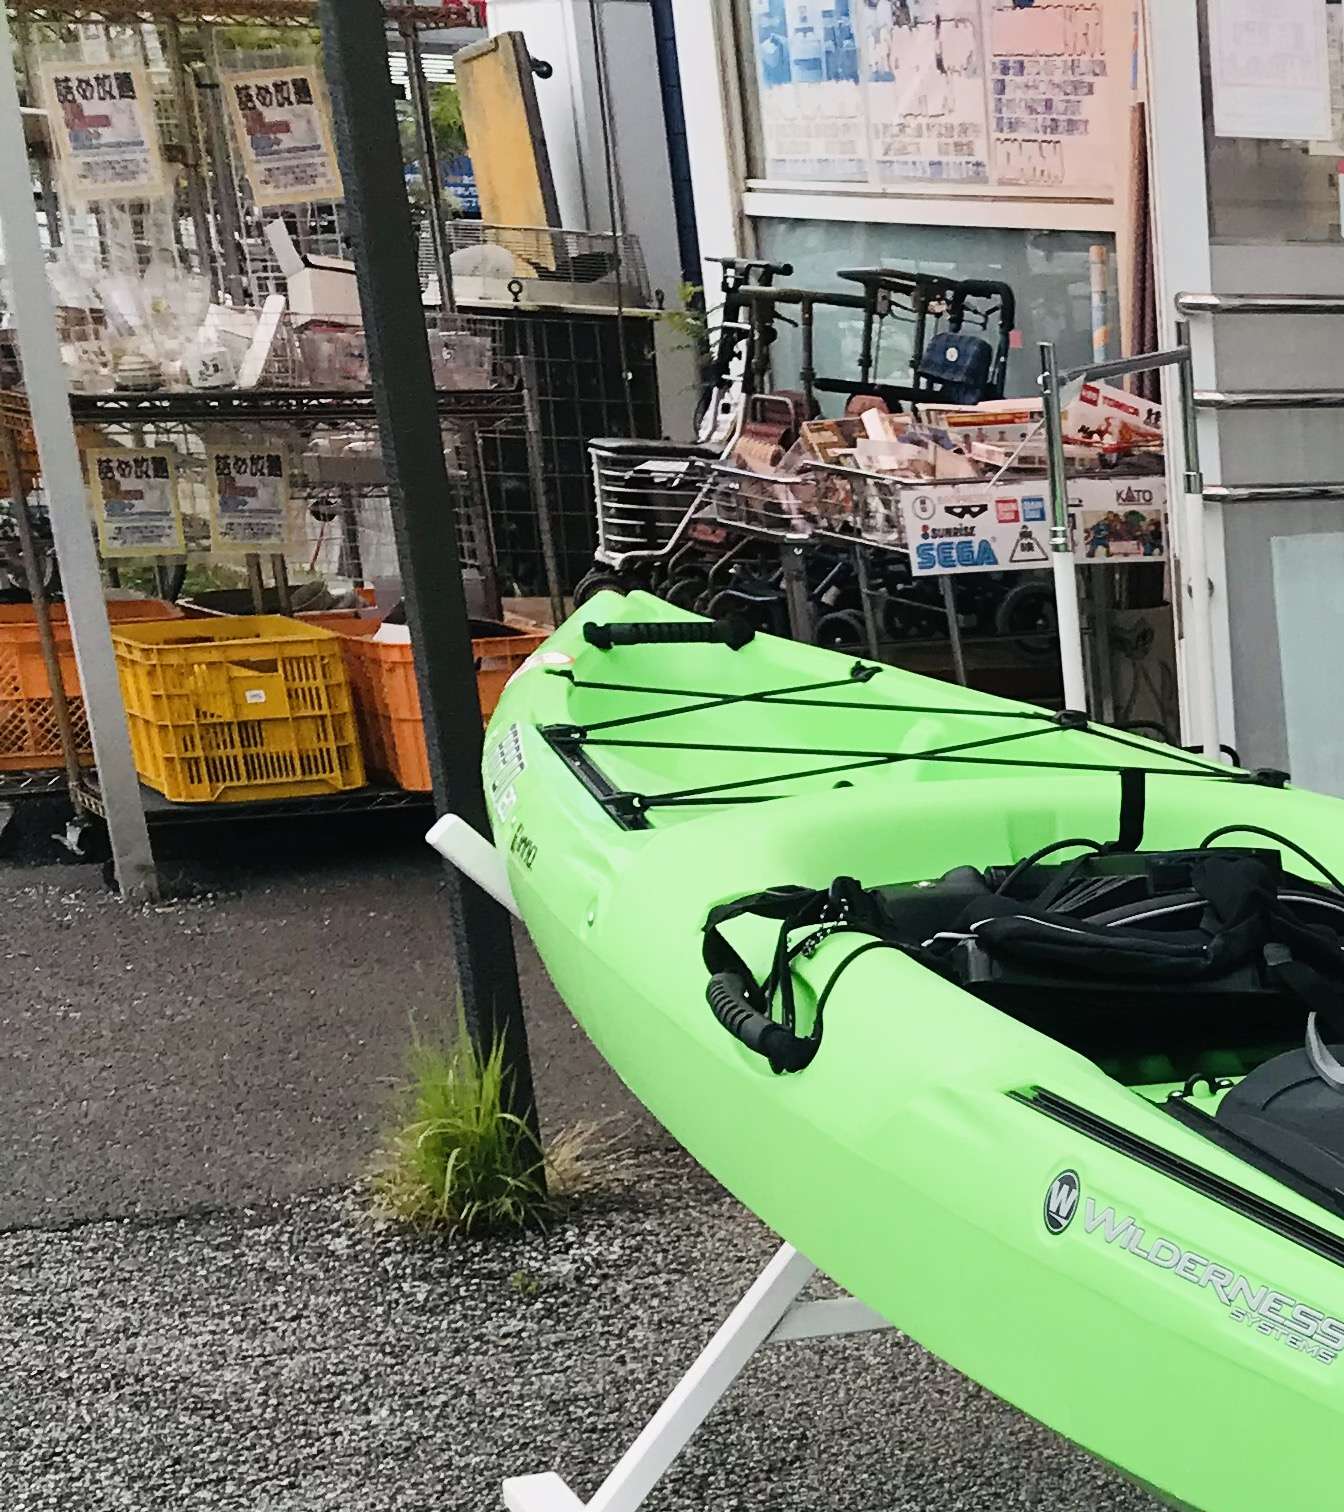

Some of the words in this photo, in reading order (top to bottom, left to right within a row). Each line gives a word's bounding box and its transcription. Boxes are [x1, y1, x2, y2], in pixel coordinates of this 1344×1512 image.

[1115, 486, 1152, 505] KATO
[916, 539, 998, 570] SEGA
[1229, 1306, 1340, 1366] SYSTEMS
